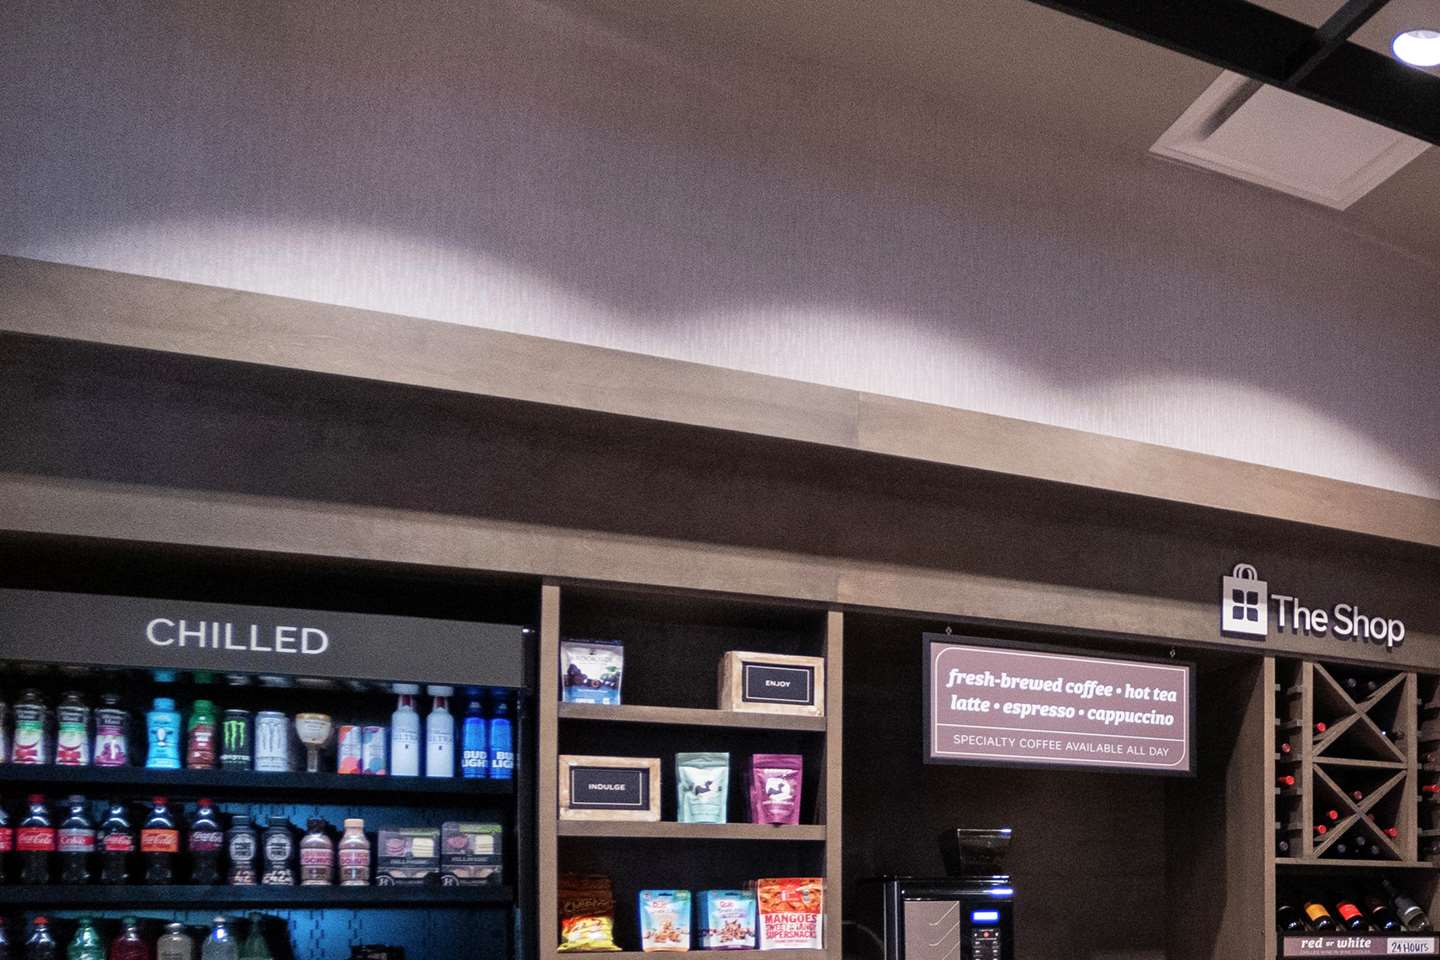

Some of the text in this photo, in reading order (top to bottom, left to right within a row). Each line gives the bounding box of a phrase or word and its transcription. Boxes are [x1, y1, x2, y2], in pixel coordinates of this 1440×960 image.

[1271, 594, 1405, 647] The Shop
[145, 618, 329, 655] CHILLED
[765, 679, 791, 688] ENJOY
[946, 668, 1177, 702] fresh-brewed coffee hot tea
[950, 694, 1175, 726] latte espresso cappuccino
[953, 734, 1170, 757] SPECIALTY COFFEE AVAILABLE ALL DAY
[463, 750, 487, 760] BUD
[588, 783, 626, 791] INDULGE
[765, 915, 816, 923] MANGOES
[1301, 938, 1323, 949] red
[1337, 937, 1372, 949] white
[1391, 942, 1402, 952] 24
